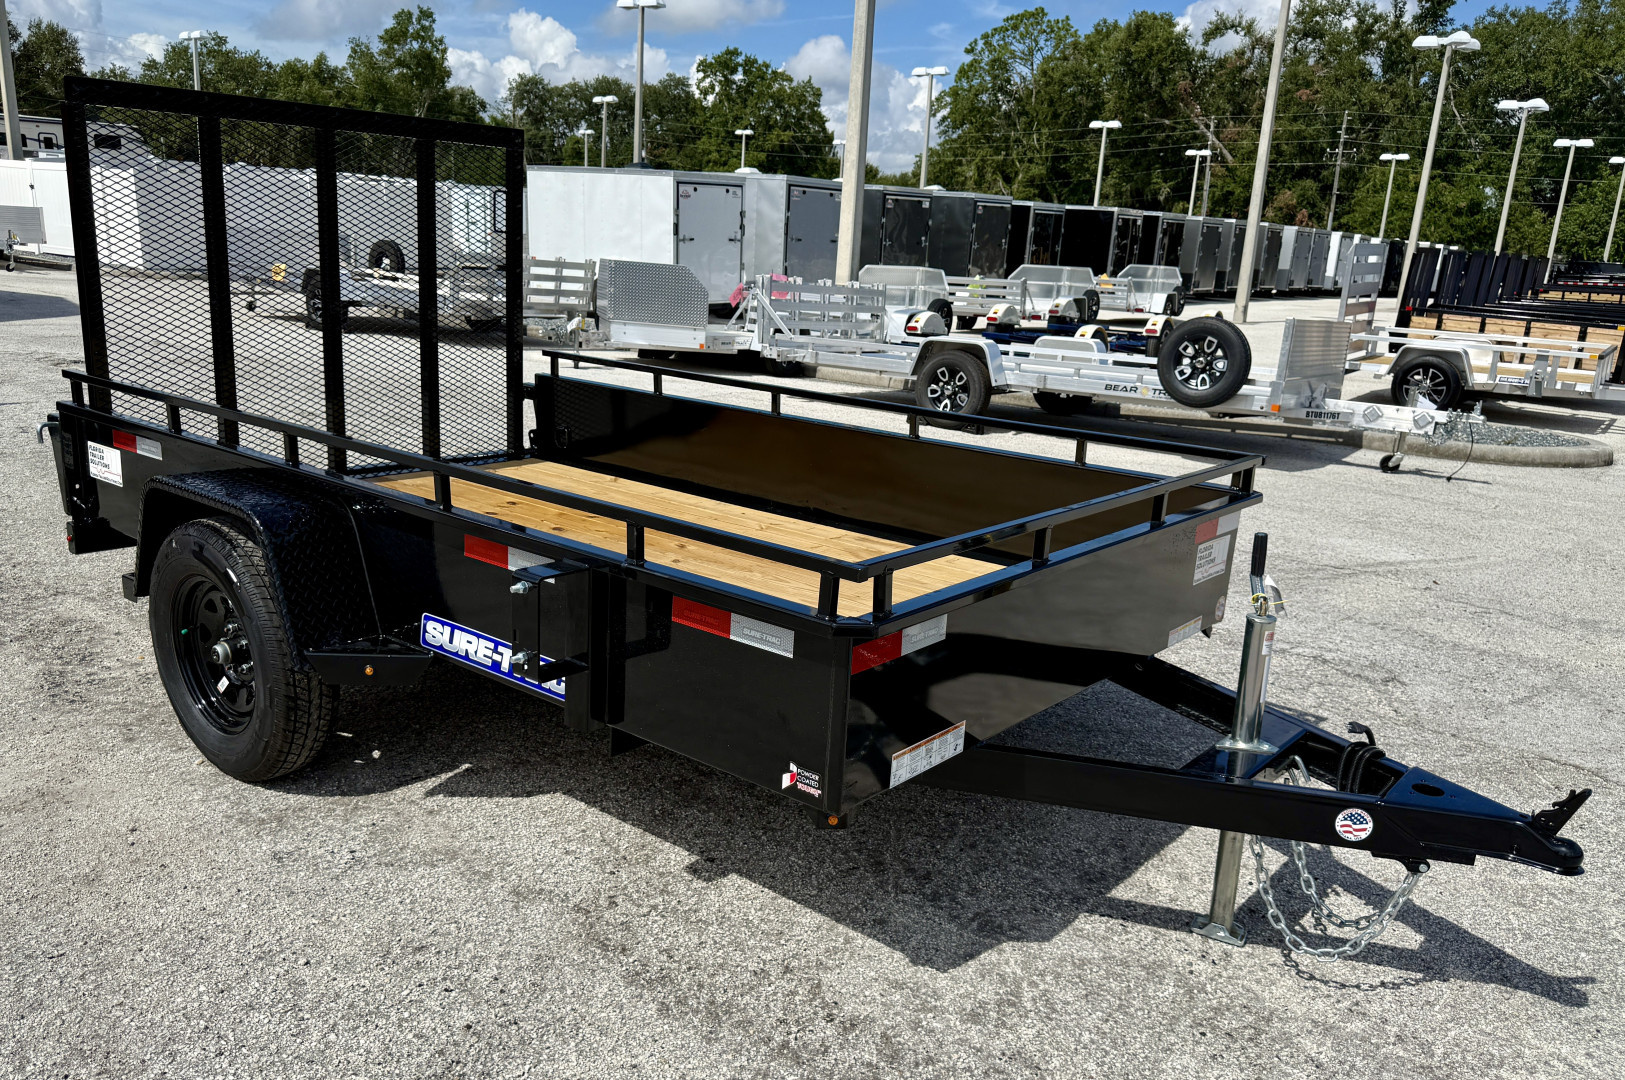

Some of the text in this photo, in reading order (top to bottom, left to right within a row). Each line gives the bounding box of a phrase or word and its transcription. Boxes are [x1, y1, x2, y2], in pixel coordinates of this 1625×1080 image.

[1105, 384, 1138, 393] BEAR
[90, 451, 105, 461] TRAILER
[90, 458, 110, 469] SOLUTIONS
[743, 627, 781, 645] SURE-TRAC
[797, 768, 819, 781] POWDER
[797, 775, 819, 788] COATED
